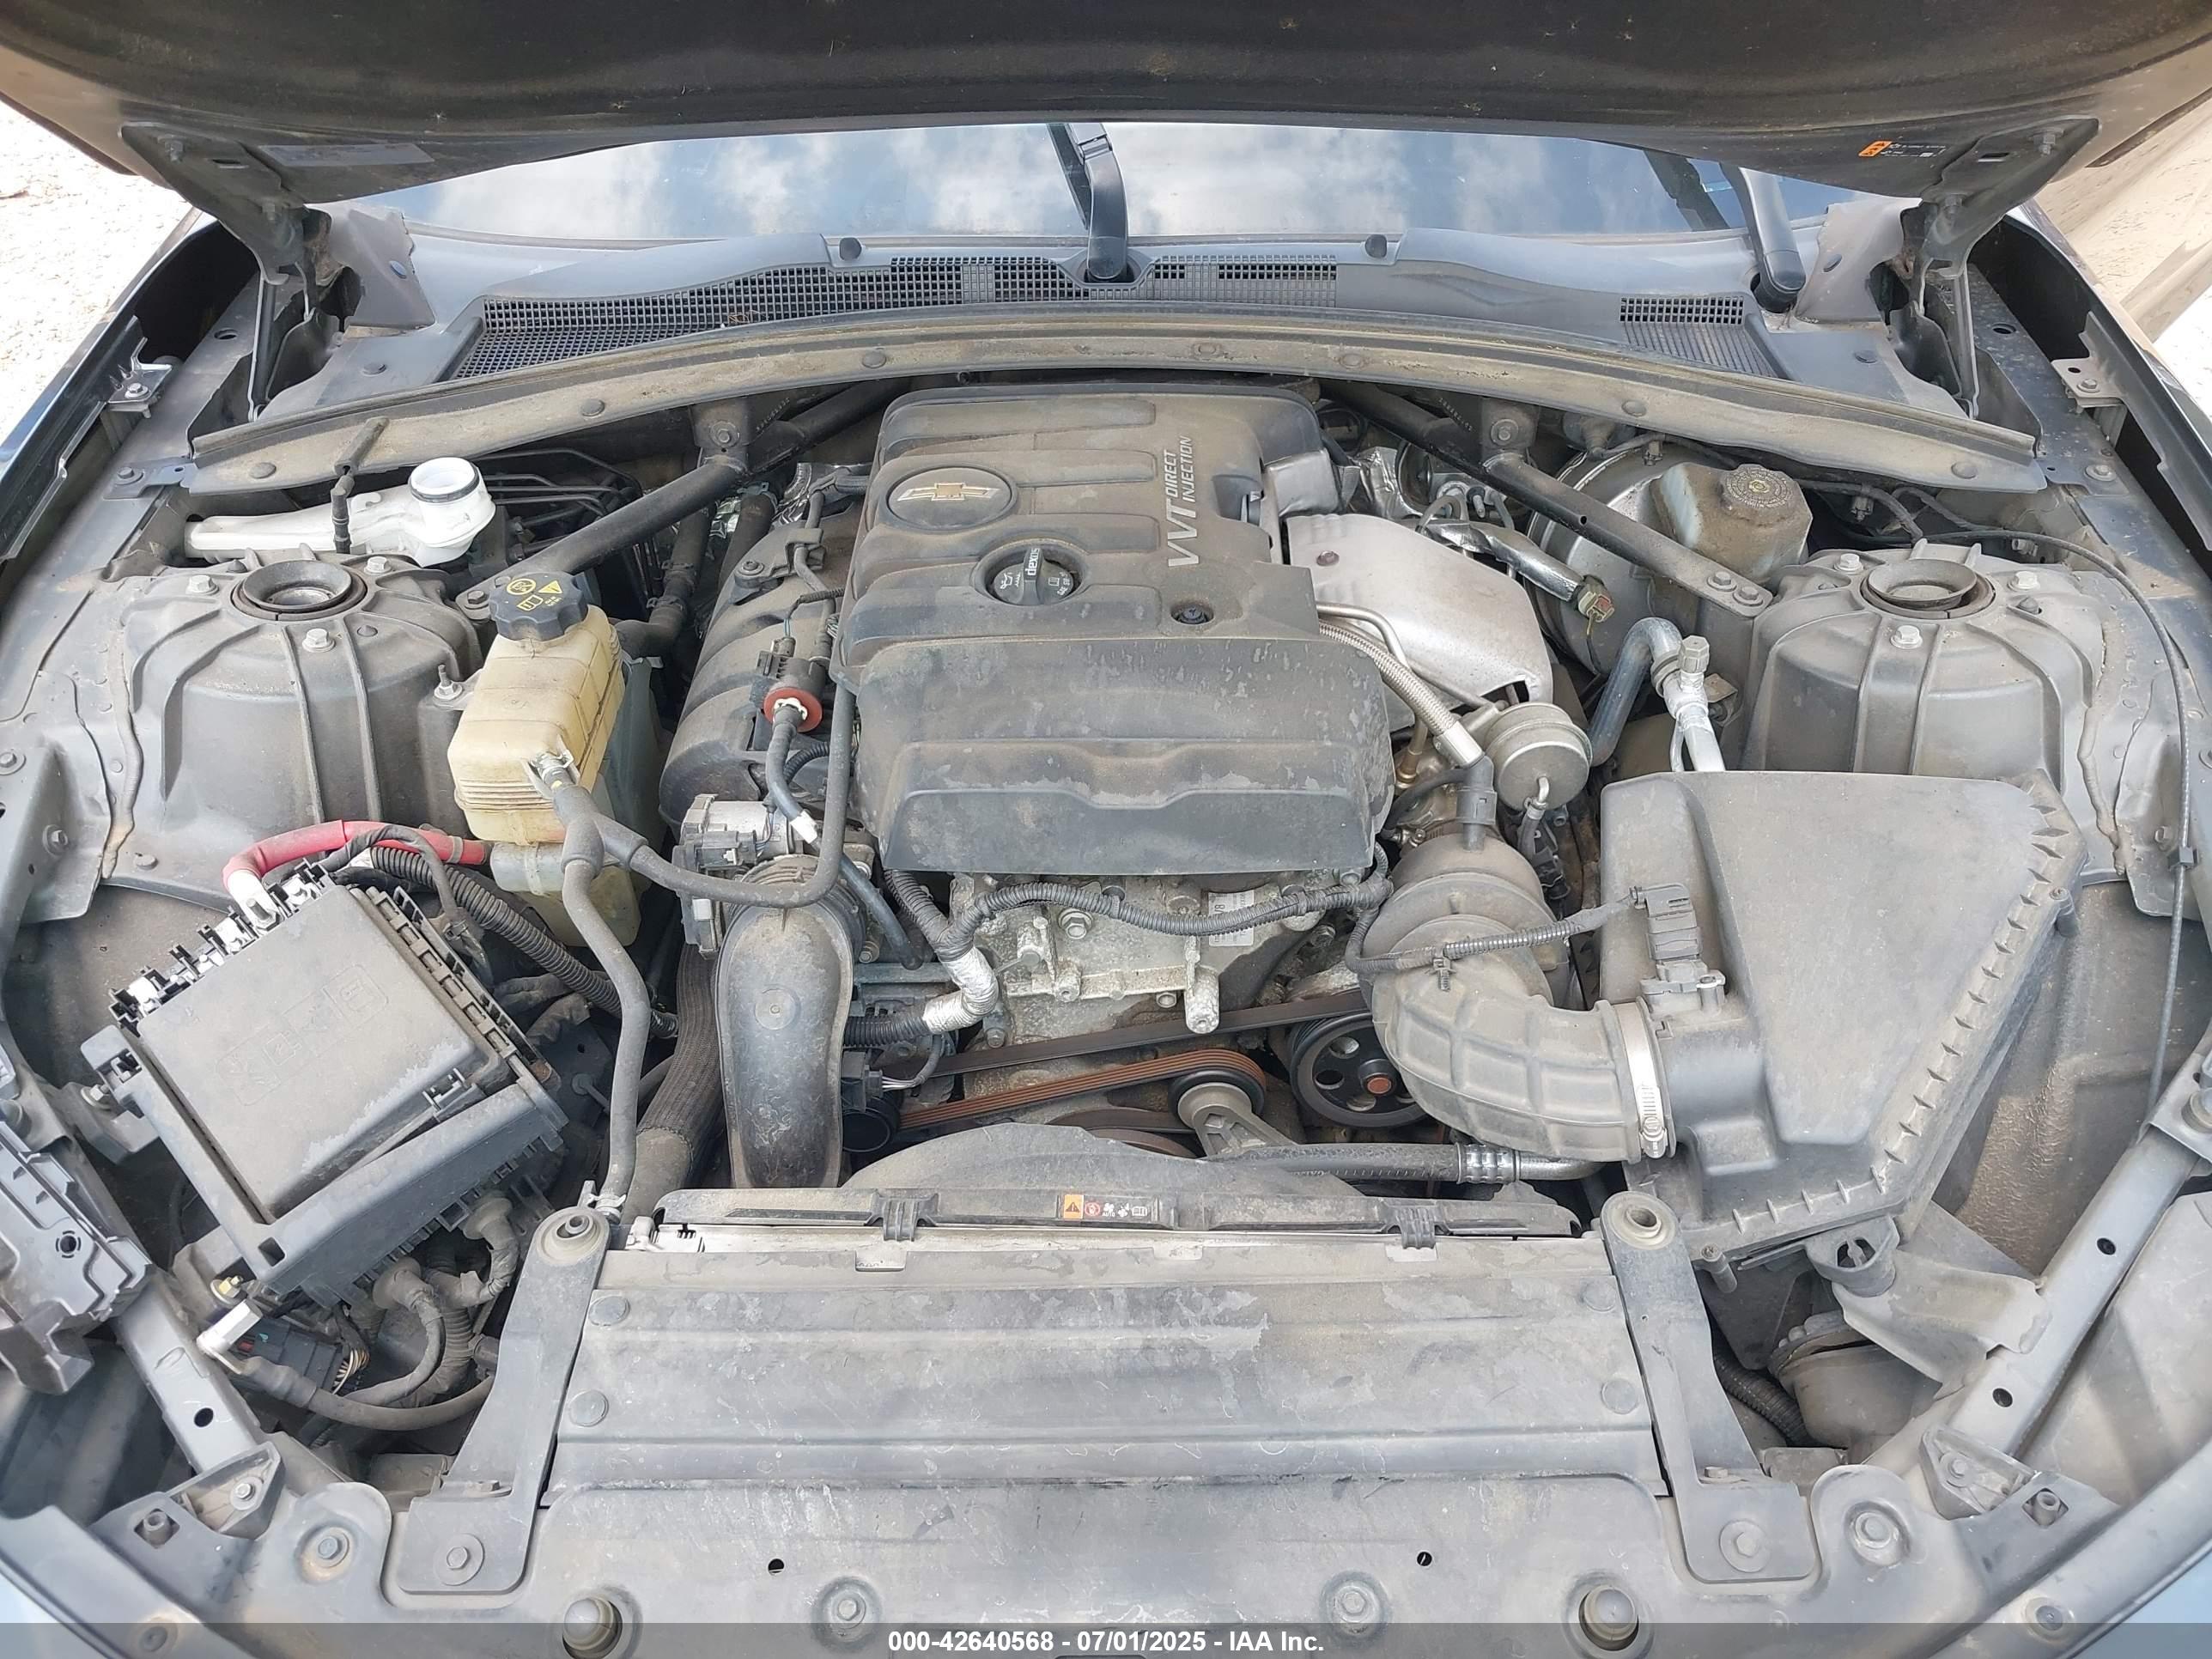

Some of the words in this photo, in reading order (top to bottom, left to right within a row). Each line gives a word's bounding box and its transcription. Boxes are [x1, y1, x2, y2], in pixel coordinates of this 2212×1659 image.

[1164, 449, 1179, 498] DIRECT
[1180, 435, 1196, 503] INJECTION
[1024, 547, 1040, 576] dexos
[1166, 497, 1200, 568] VVT
